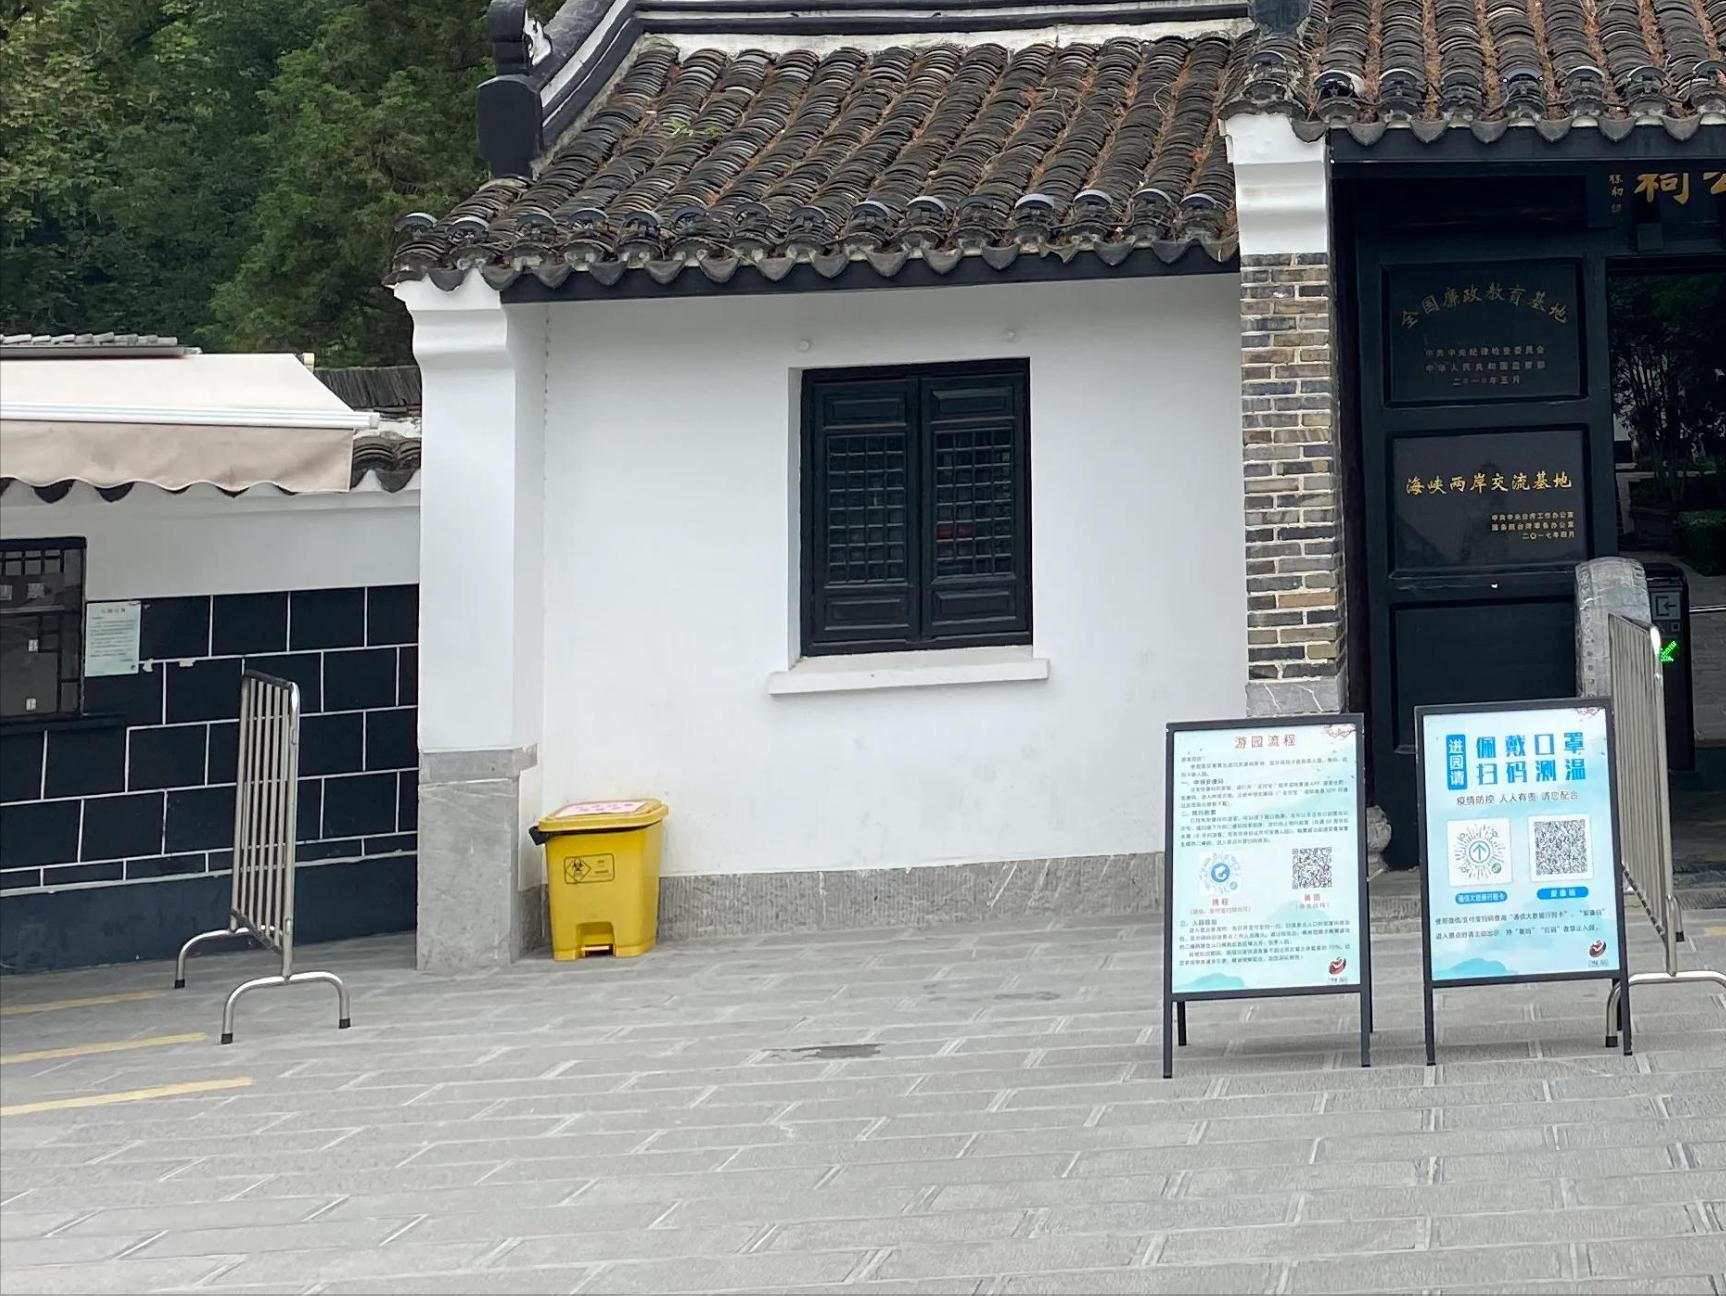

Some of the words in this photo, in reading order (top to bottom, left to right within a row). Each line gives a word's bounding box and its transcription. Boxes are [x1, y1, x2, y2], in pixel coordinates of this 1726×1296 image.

[1401, 282, 1569, 329] 全国廉政教育基地
[1405, 470, 1573, 496] 海峡两岸交流基地
[1234, 734, 1297, 750] 游园流程
[1476, 731, 1585, 760] 佩戴口罩
[1476, 758, 1587, 786] 扫码测温
[1456, 795, 1495, 806] 疫情防控
[1500, 792, 1537, 803] 人人有责
[1541, 790, 1580, 802] 请您配合
